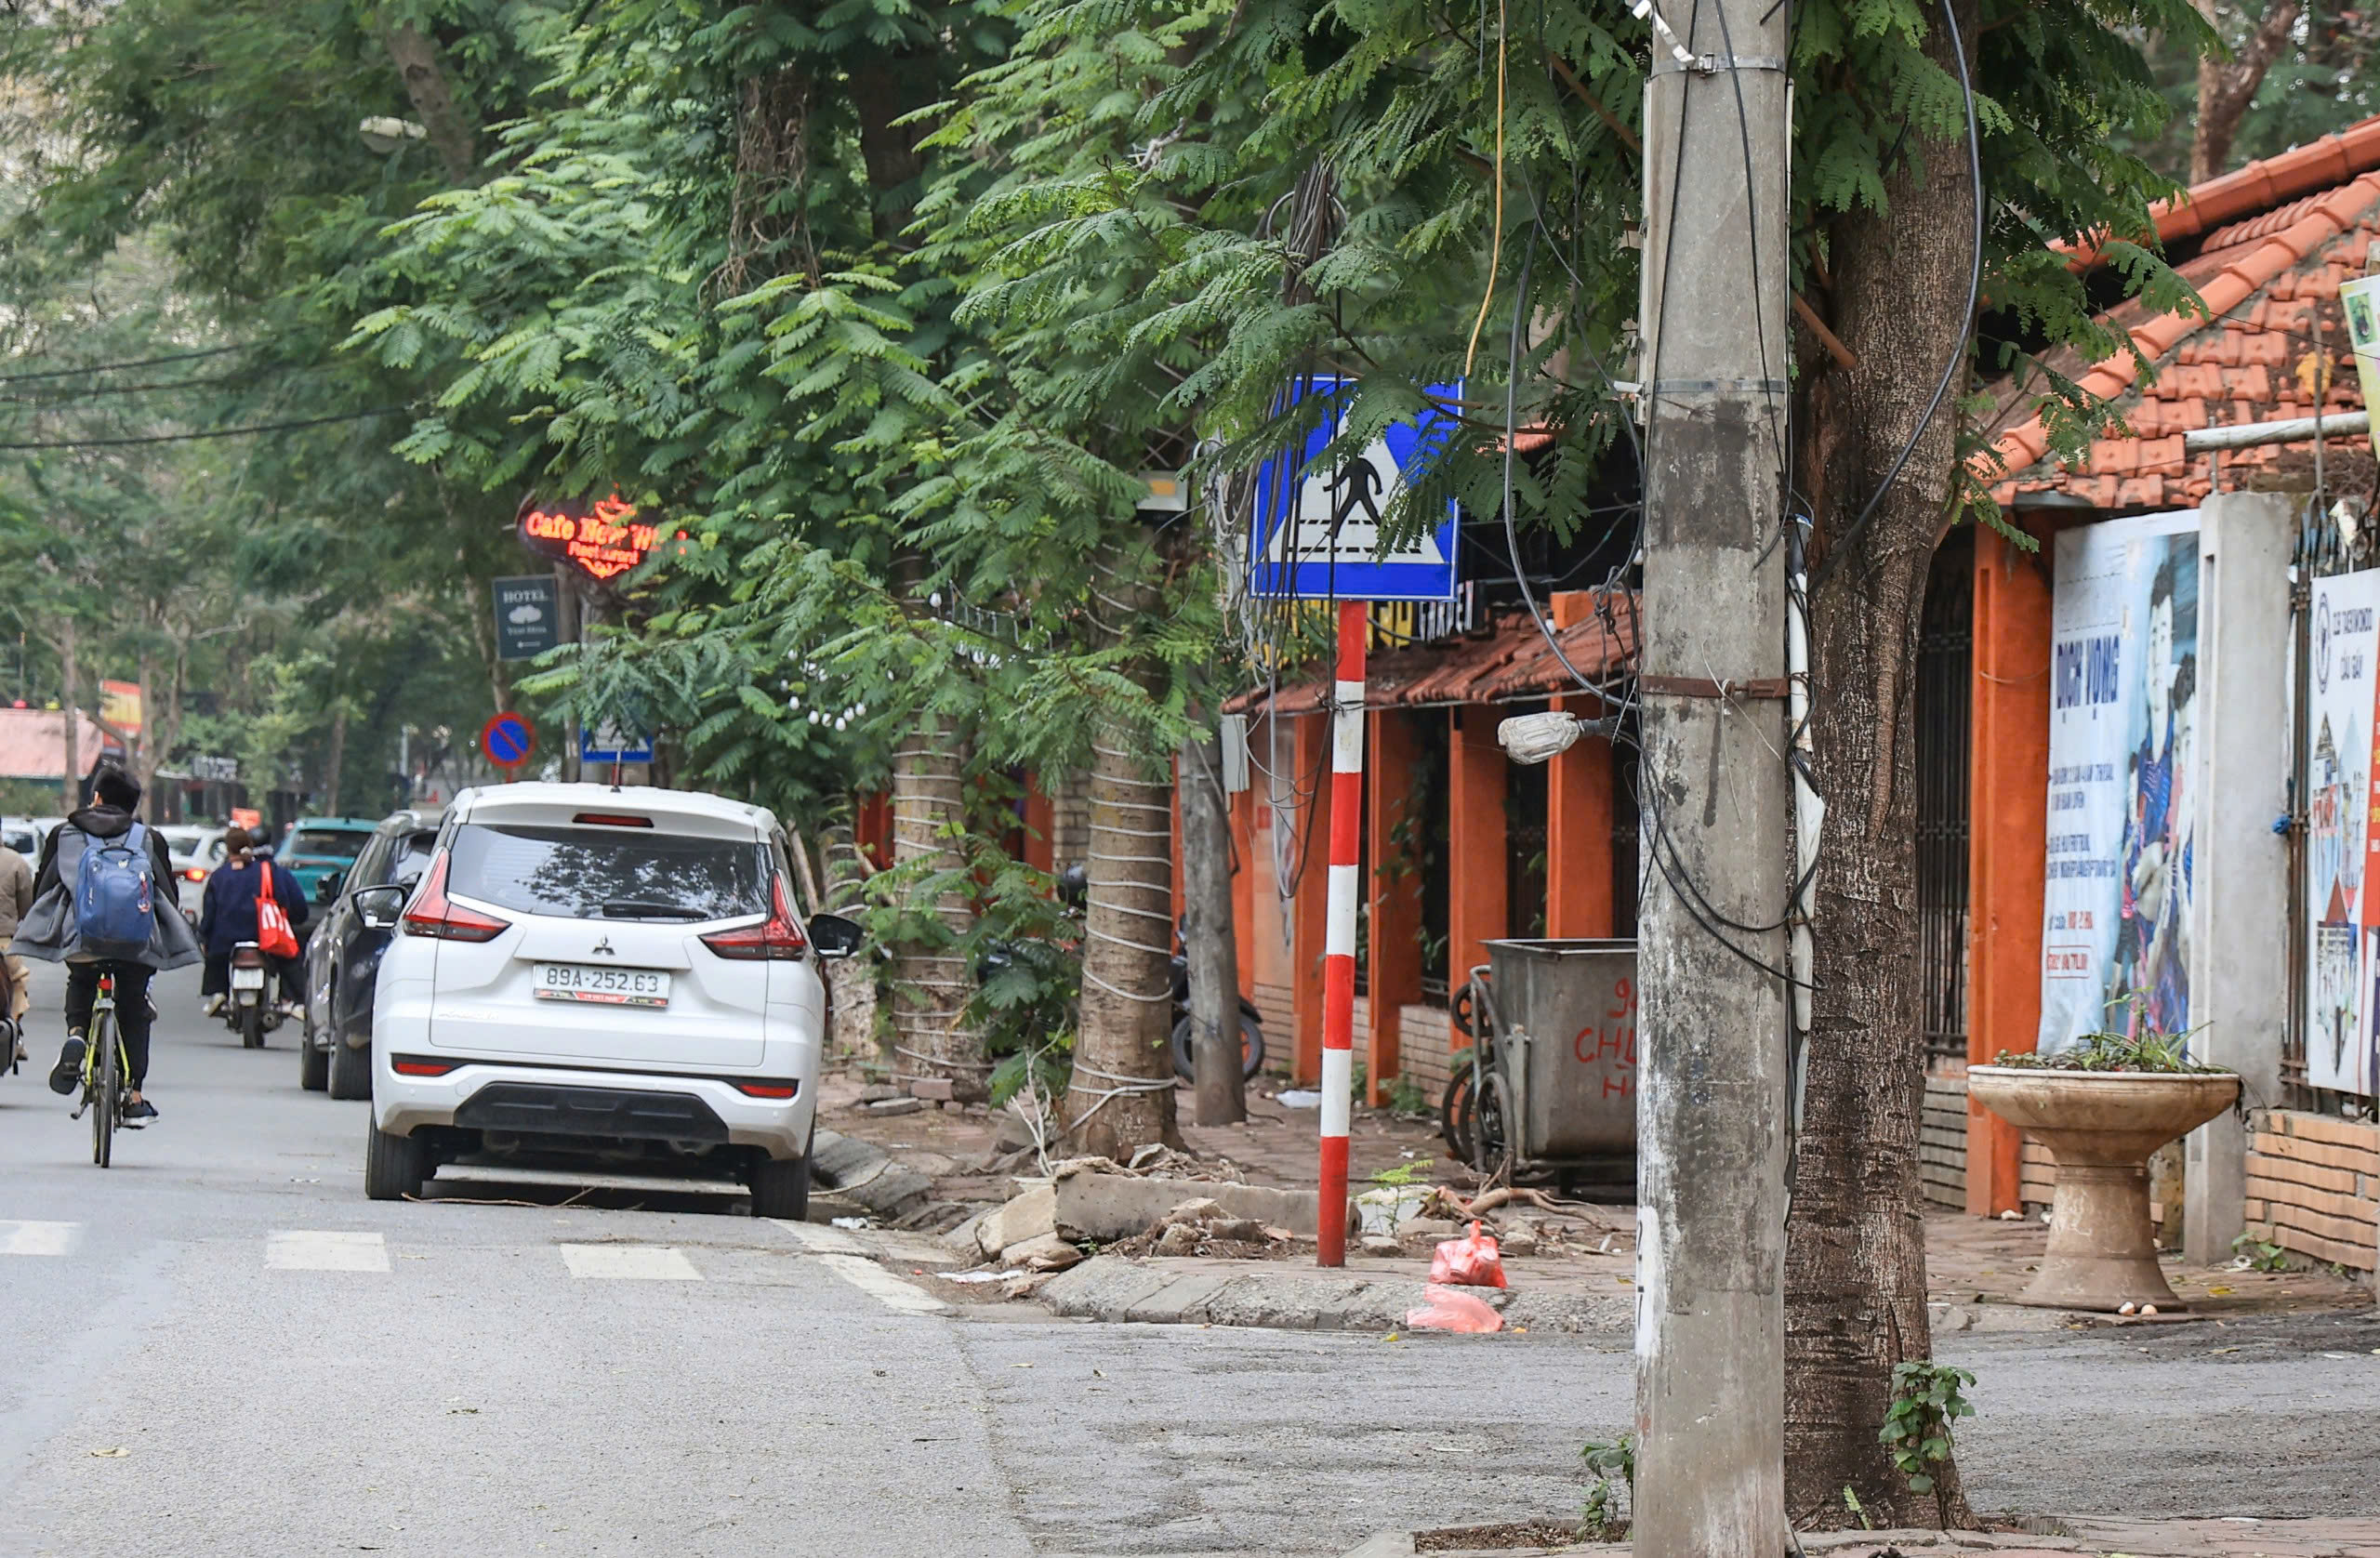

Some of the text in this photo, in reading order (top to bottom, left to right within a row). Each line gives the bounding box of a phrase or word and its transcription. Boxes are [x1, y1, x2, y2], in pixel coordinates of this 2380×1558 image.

[525, 511, 575, 540] Cafe
[503, 588, 549, 603] HOTEL
[547, 967, 658, 993] 89A-252.63
